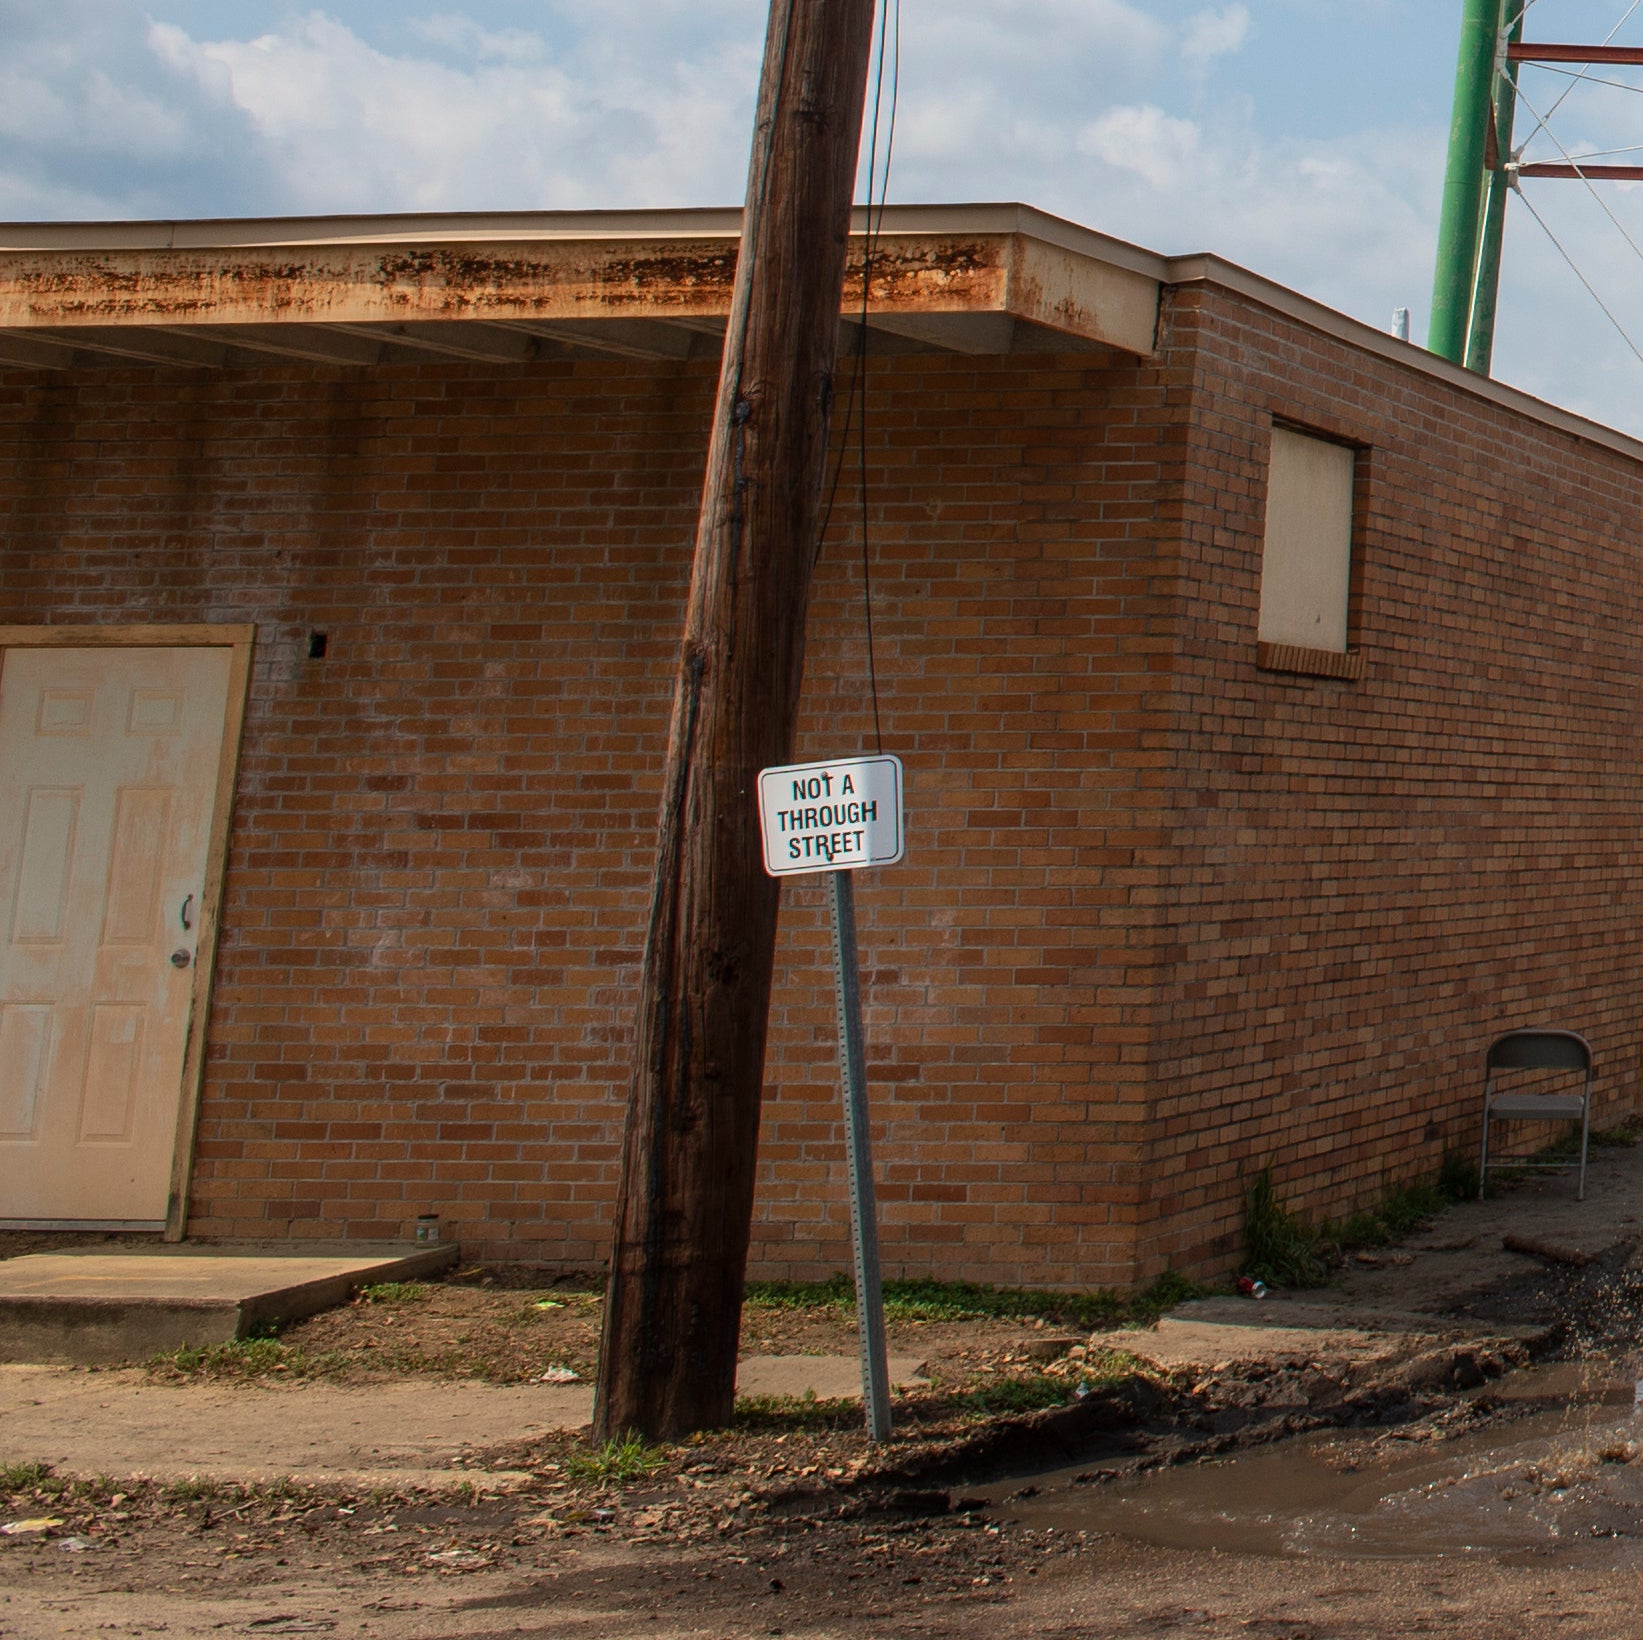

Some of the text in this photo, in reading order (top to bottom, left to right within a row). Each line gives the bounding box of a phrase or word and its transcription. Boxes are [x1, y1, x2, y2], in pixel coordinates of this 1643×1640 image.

[792, 774, 855, 801] NOT A
[777, 800, 878, 832] THROUGH
[788, 830, 865, 860] STREET
